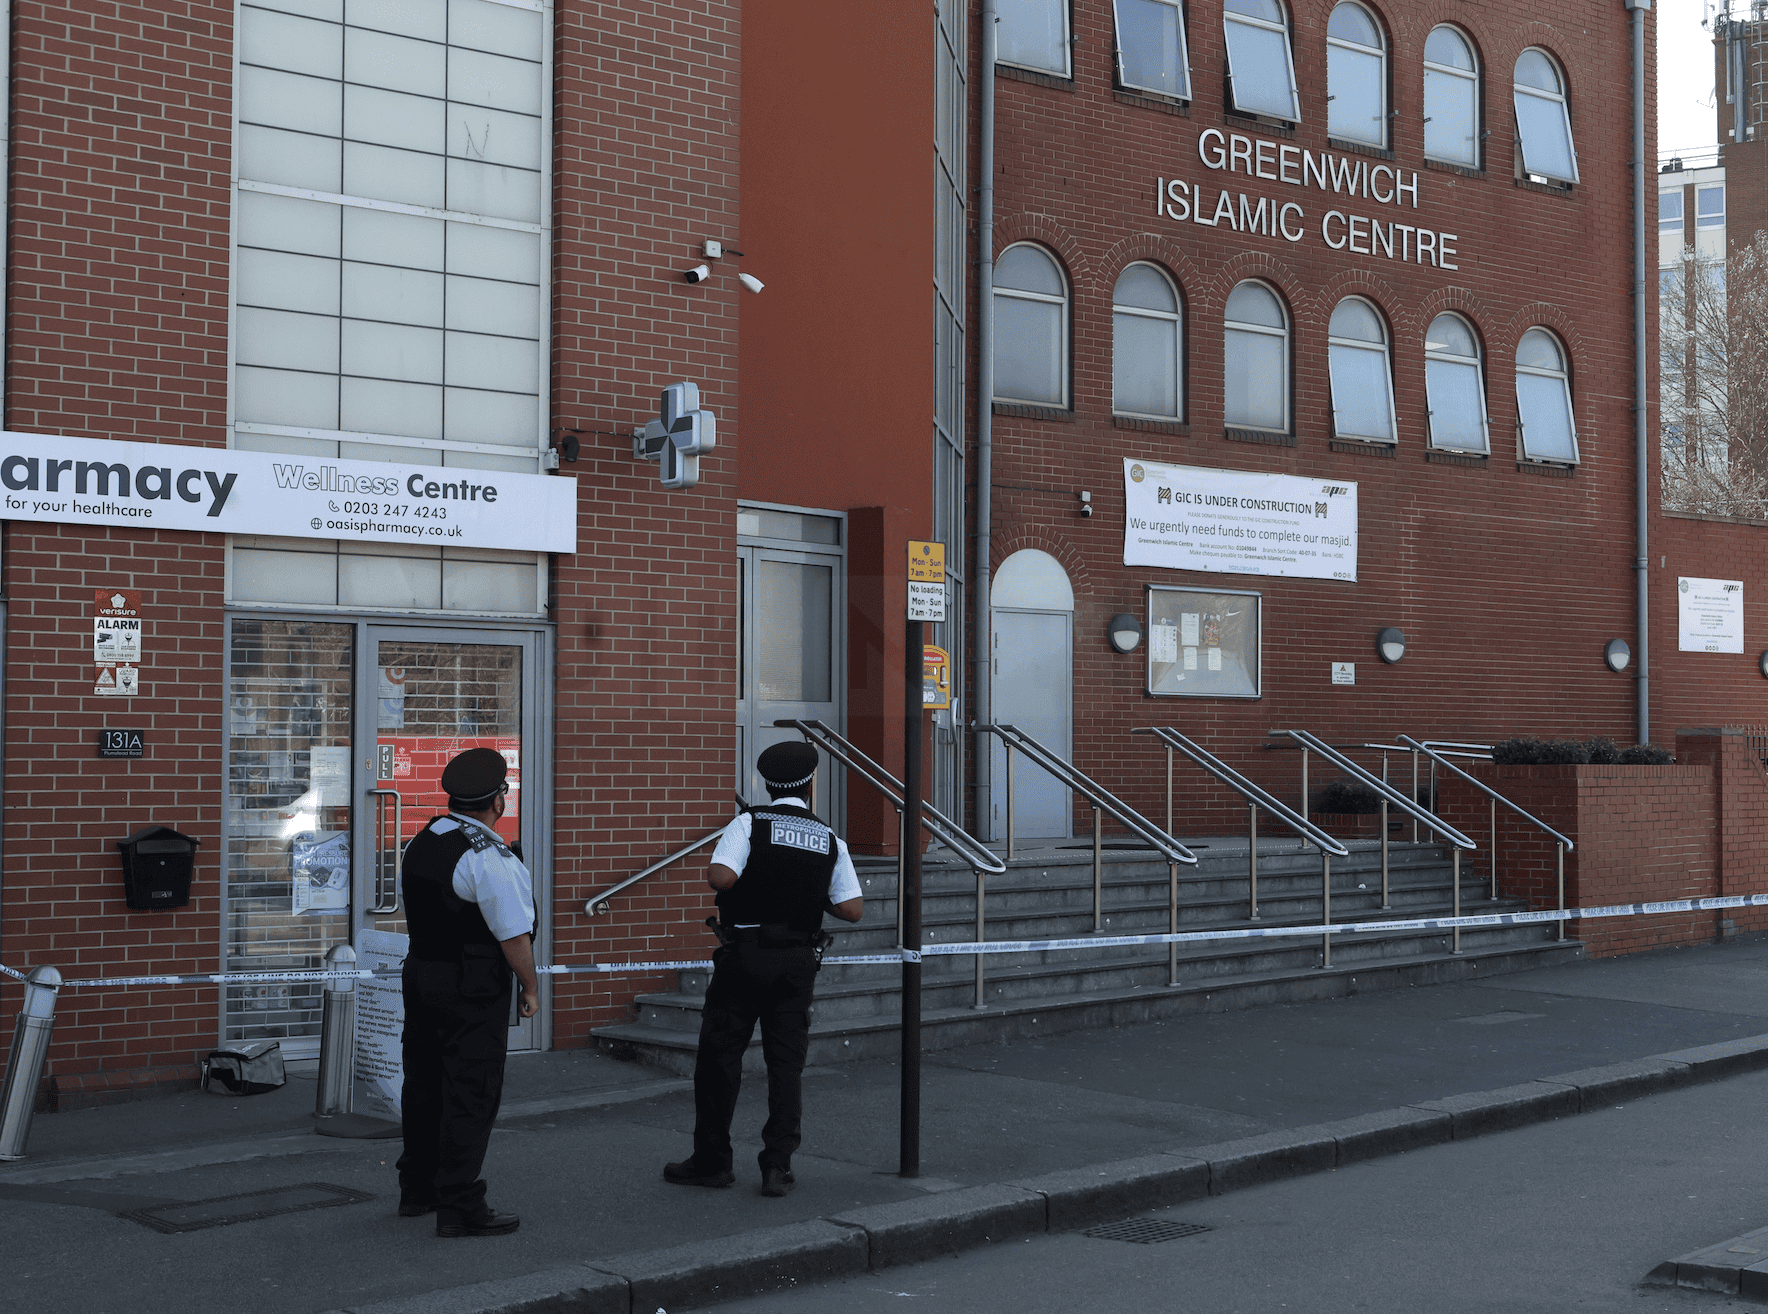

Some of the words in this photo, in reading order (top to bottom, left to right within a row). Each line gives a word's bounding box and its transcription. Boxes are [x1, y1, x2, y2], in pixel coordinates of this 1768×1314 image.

[1198, 128, 1419, 208] GREENWICH
[1157, 177, 1304, 242] ISLAMIC
[1322, 210, 1459, 270] CENTRE
[0, 455, 238, 517] armacy
[273, 463, 400, 496] Wellness
[406, 473, 498, 503] Centre
[6, 495, 28, 509] for
[33, 500, 67, 513] your
[73, 500, 153, 517] healthcare
[344, 501, 379, 515] 0203
[383, 503, 409, 517] 247
[413, 506, 447, 520] 4243
[1175, 492, 1191, 504] GIC
[1194, 493, 1203, 505] IS
[1205, 495, 1238, 508] UNDER
[1240, 498, 1312, 515] CONSTRUCTION
[326, 518, 463, 538] oasispharmacy.co.uk
[1130, 517, 1147, 530] We
[1149, 520, 1190, 535] urgently
[1192, 524, 1216, 535] need
[1218, 525, 1244, 538] funds
[1247, 529, 1257, 539] to
[1258, 530, 1301, 543] complete
[1303, 534, 1319, 544] our
[1321, 535, 1352, 548] masjid.
[1138, 537, 1162, 545] Greenwich
[911, 557, 926, 566] Mon
[929, 558, 942, 567] Sun
[911, 567, 925, 577] 7am
[929, 569, 943, 579] 7pm
[910, 585, 920, 593] No
[921, 585, 943, 596] loading
[911, 597, 926, 605] Mon
[929, 598, 942, 606] Sun
[100, 608, 137, 616] verisure
[910, 607, 925, 616] 7am
[928, 608, 943, 618] 7pm
[97, 619, 138, 630] ALARM
[106, 731, 142, 748] 131A
[775, 823, 827, 837] METROPOLITAN
[774, 828, 827, 852] POLICE
[294, 856, 348, 866] PROMOTION
